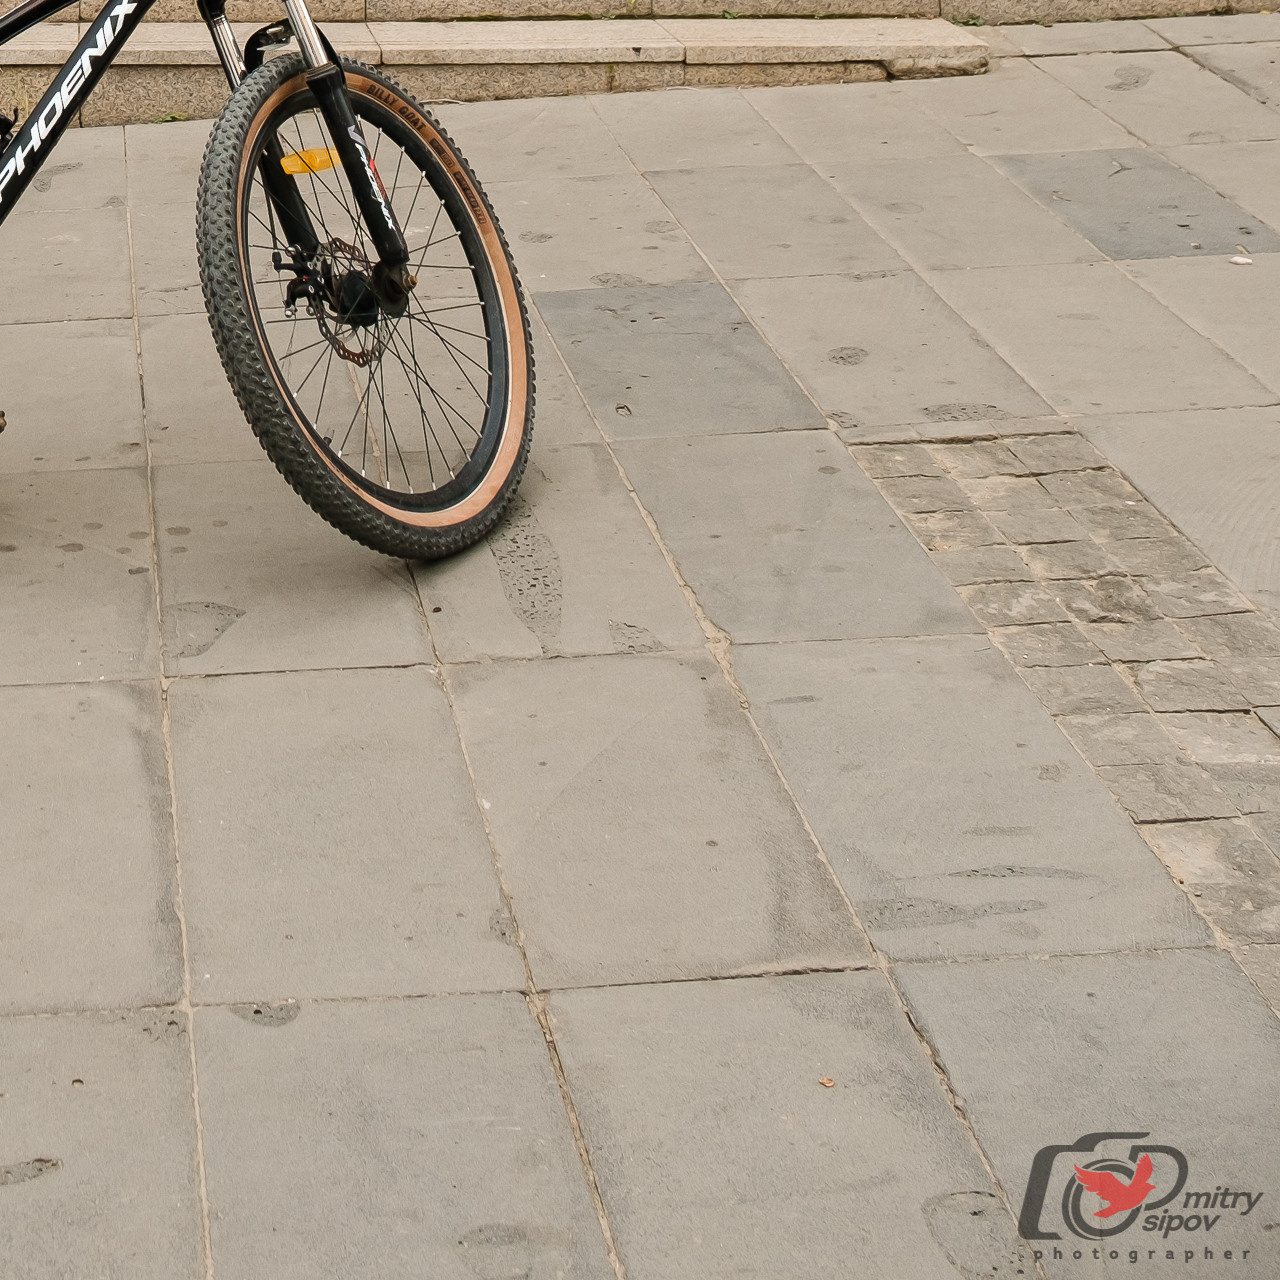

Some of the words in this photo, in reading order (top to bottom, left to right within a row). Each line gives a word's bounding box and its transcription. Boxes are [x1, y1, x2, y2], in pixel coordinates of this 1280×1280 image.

[366, 83, 399, 107] BILLY
[398, 105, 427, 131] GOAT
[354, 142, 398, 232] PHOENIX
